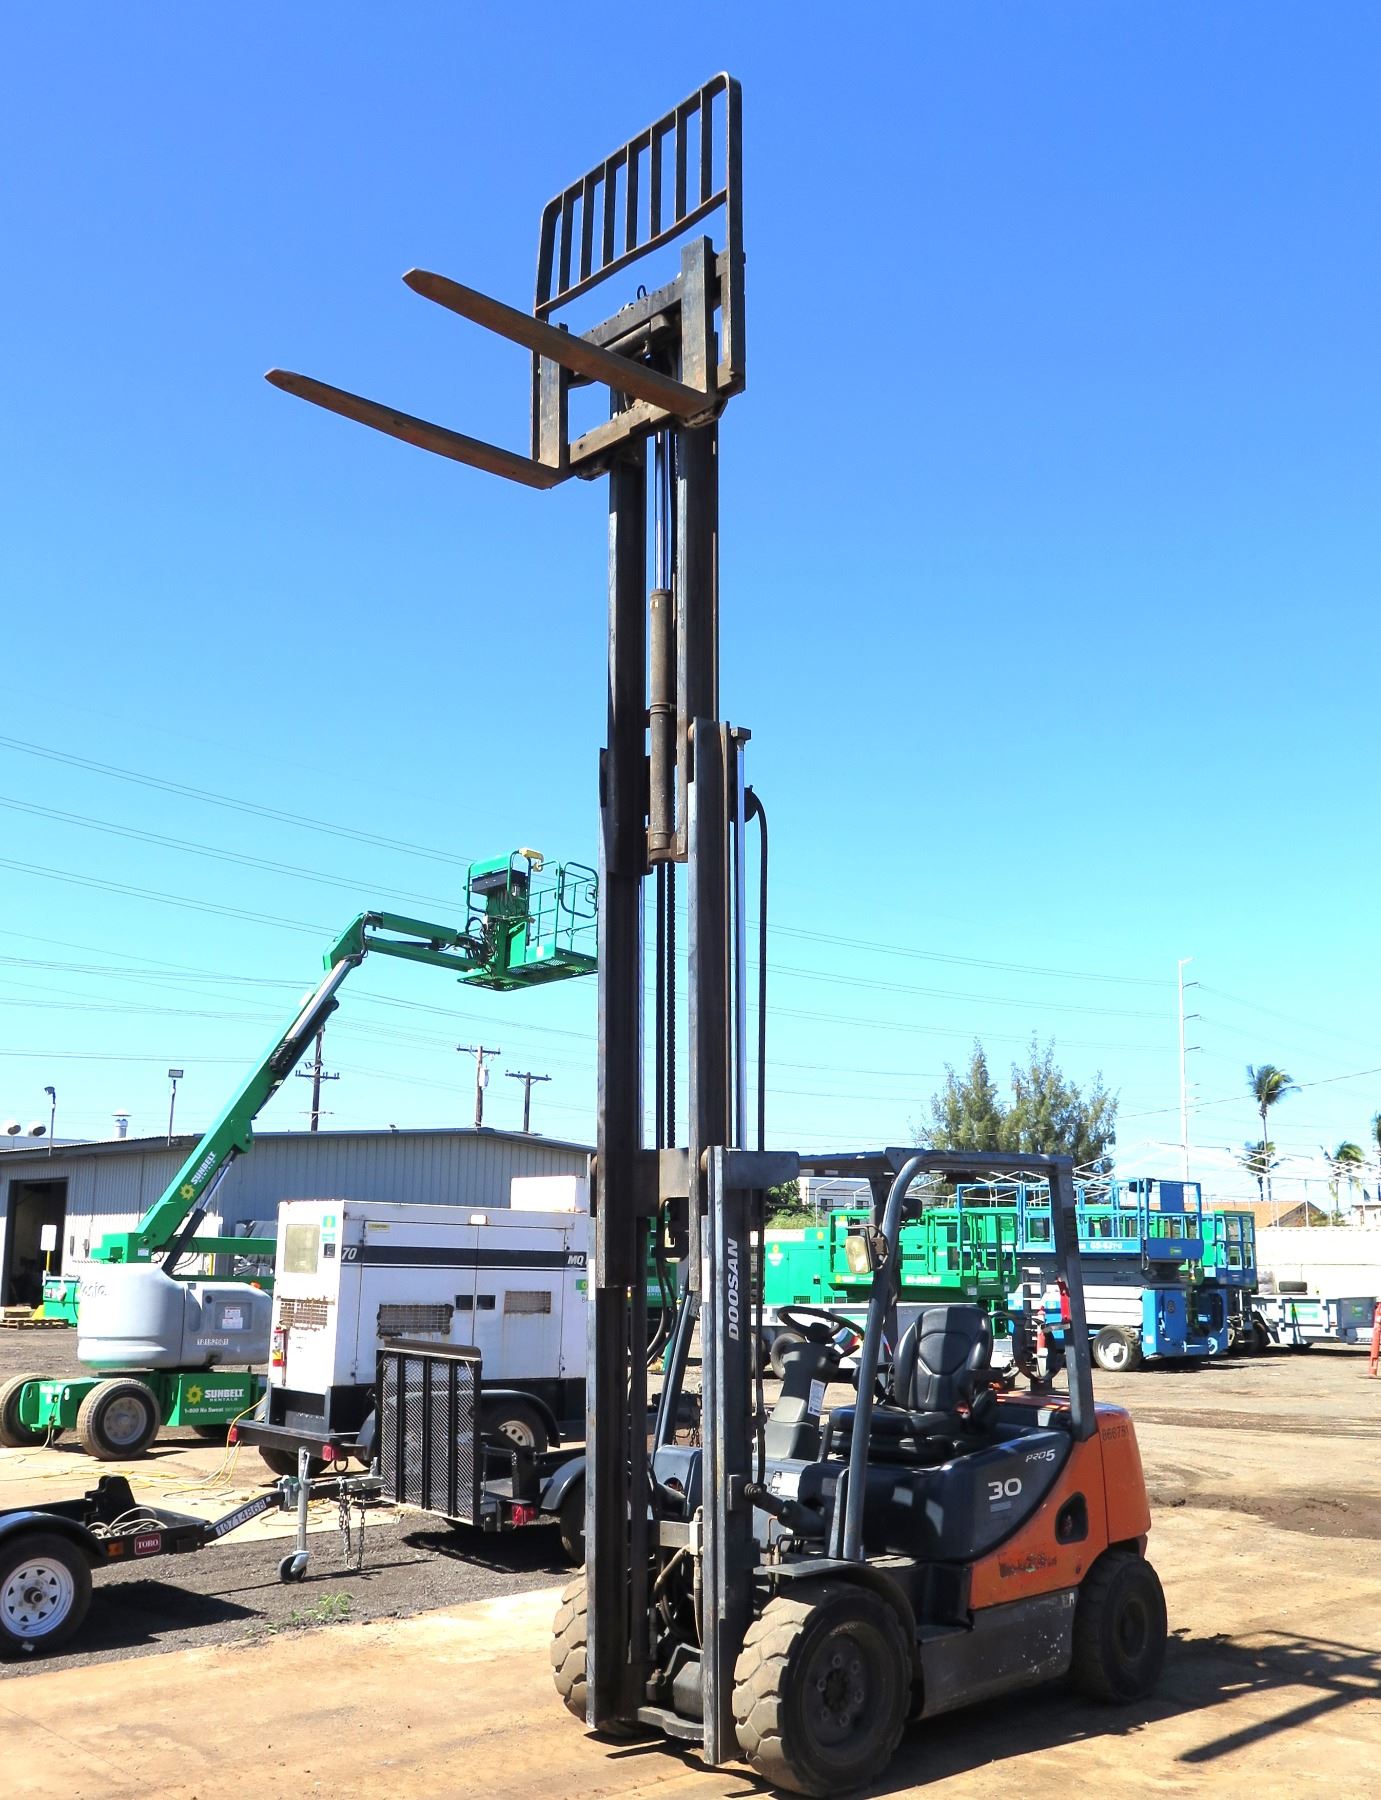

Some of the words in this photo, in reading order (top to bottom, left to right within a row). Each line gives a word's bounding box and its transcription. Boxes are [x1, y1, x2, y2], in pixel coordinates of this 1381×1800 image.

[191, 1151, 216, 1185] SUNBELT
[341, 1247, 358, 1260] 70
[567, 1255, 584, 1266] MQ
[727, 1237, 739, 1340] DOOSAN
[204, 1389, 244, 1398] SUNBELT
[988, 1478, 1022, 1500] 30
[216, 1499, 267, 1536] 10714868
[137, 1538, 159, 1549] TORO
